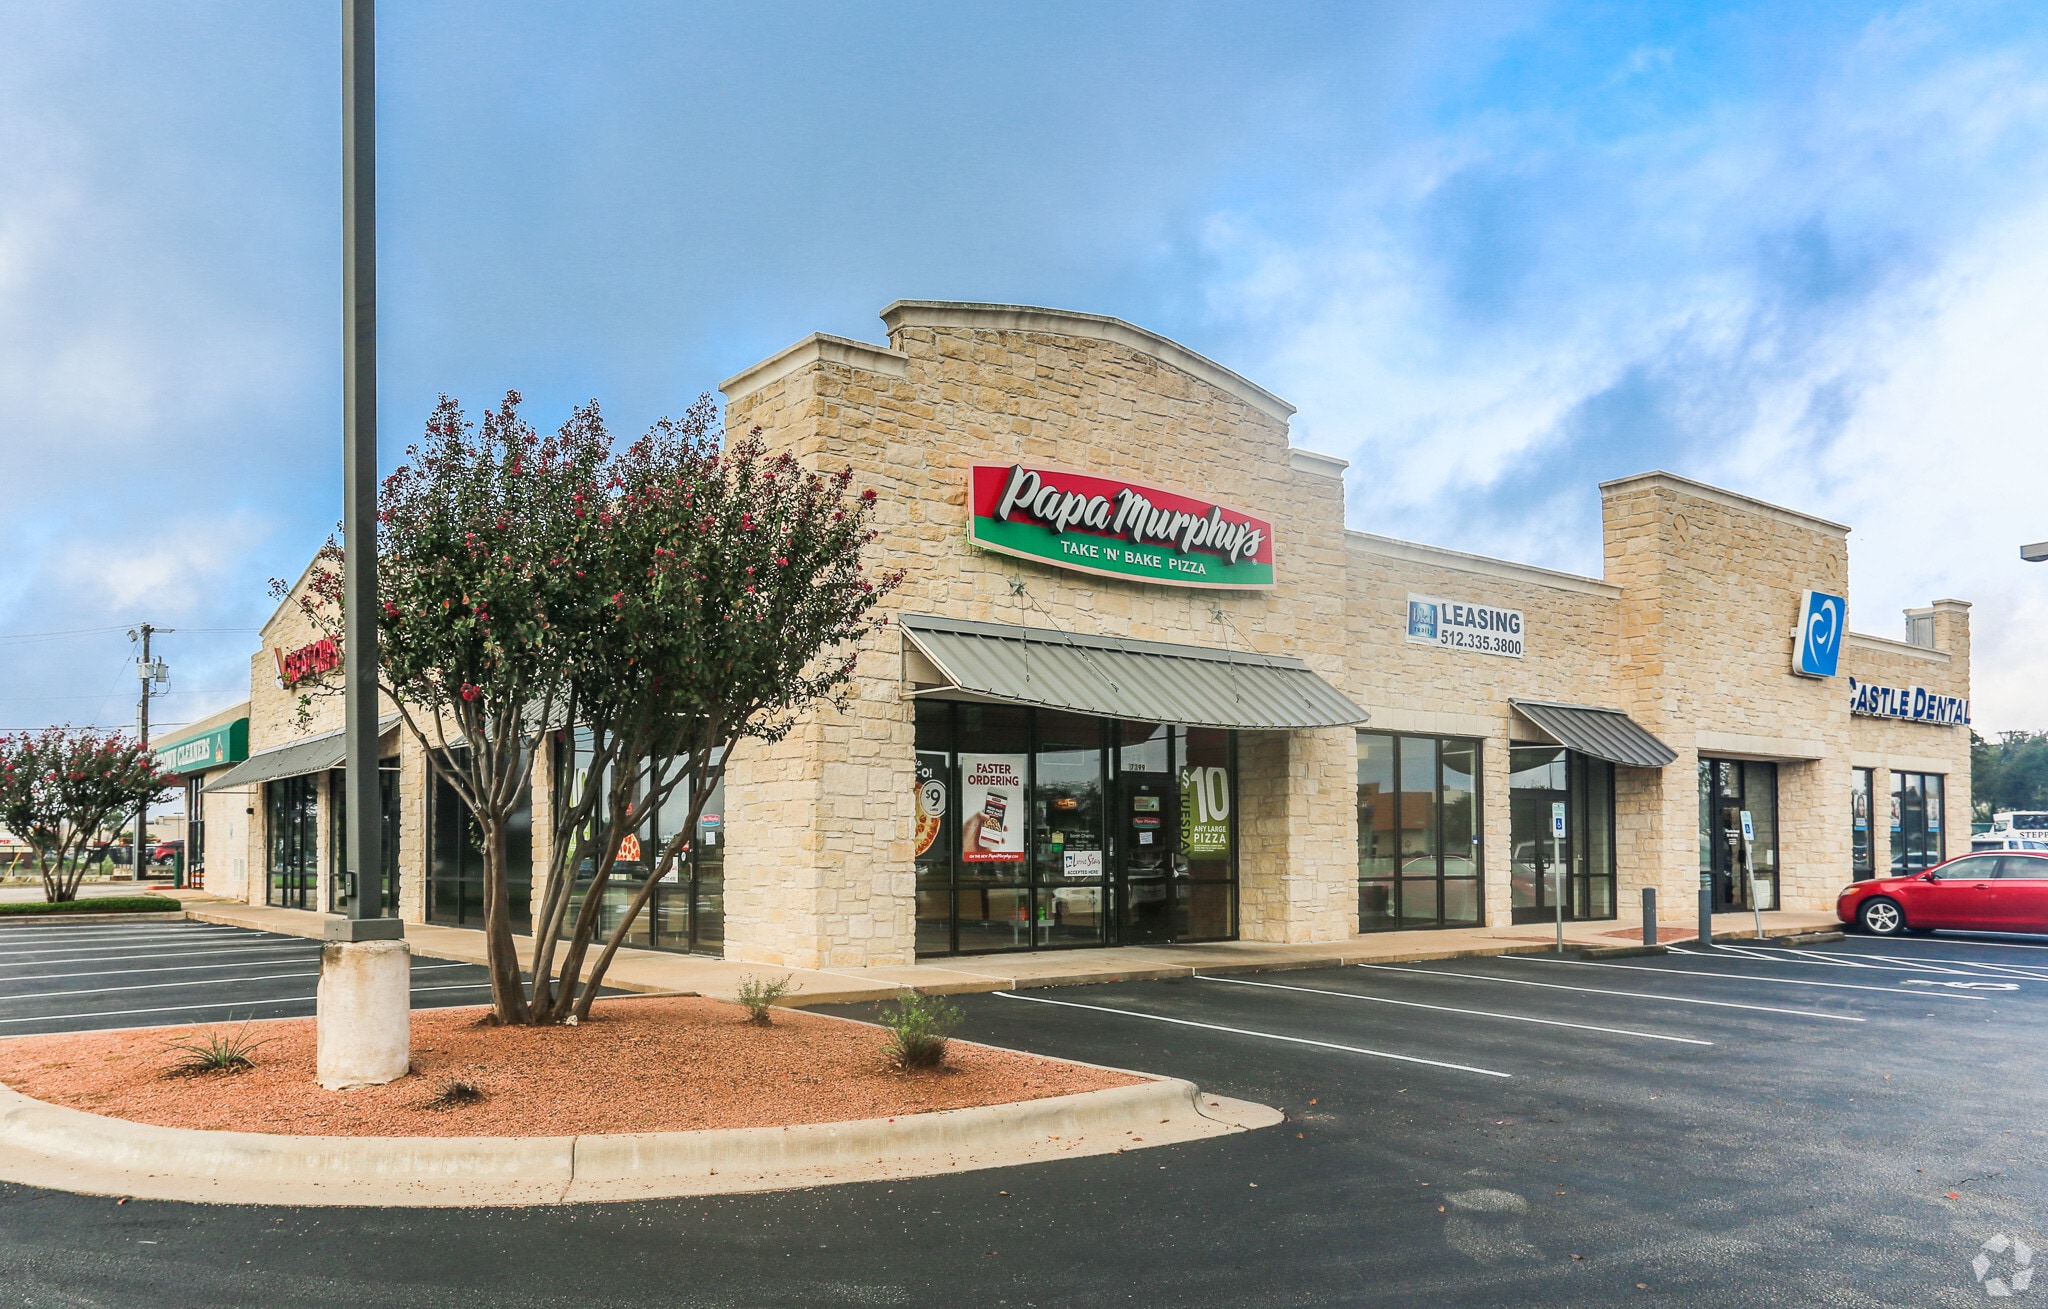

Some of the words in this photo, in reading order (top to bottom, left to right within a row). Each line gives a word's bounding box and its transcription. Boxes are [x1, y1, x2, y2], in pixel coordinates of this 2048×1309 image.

[997, 464, 1111, 535] Papa
[1111, 487, 1266, 565] Murphy's
[1060, 540, 1099, 559] TAKE
[1103, 548, 1120, 562] 'N'
[1124, 551, 1162, 569] BAKE
[1168, 558, 1207, 576] PIZZA
[1414, 626, 1433, 636] realty
[1441, 603, 1520, 634] LEASING
[1440, 629, 1521, 655] 512.335.3800
[1913, 687, 1971, 724] DENTAL
[177, 737, 210, 766] CLEANERS
[967, 775, 1019, 786] ORDERING
[976, 763, 1011, 774] FASTER
[925, 788, 941, 807] $9
[1180, 792, 1191, 860] TUESDAY
[1194, 833, 1226, 844] PIZZA
